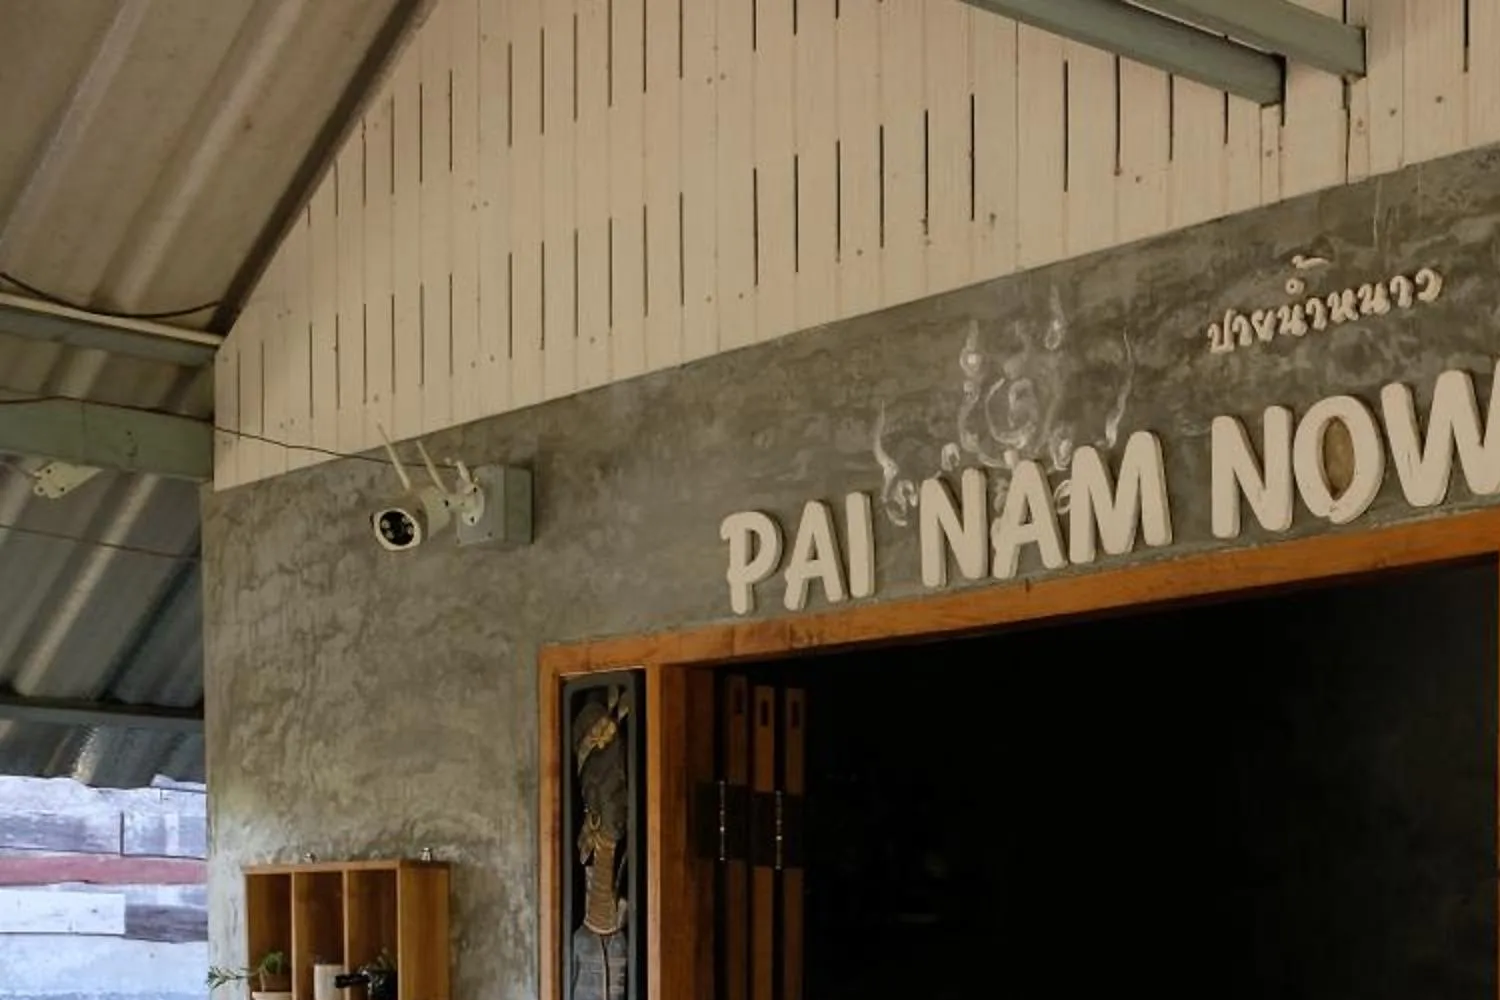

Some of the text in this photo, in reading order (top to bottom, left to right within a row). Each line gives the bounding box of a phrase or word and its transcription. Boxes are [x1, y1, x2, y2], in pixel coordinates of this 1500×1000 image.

[1206, 252, 1443, 355] ปายน้ำหนาว
[721, 489, 875, 614] PAI
[921, 431, 1172, 588] NAM
